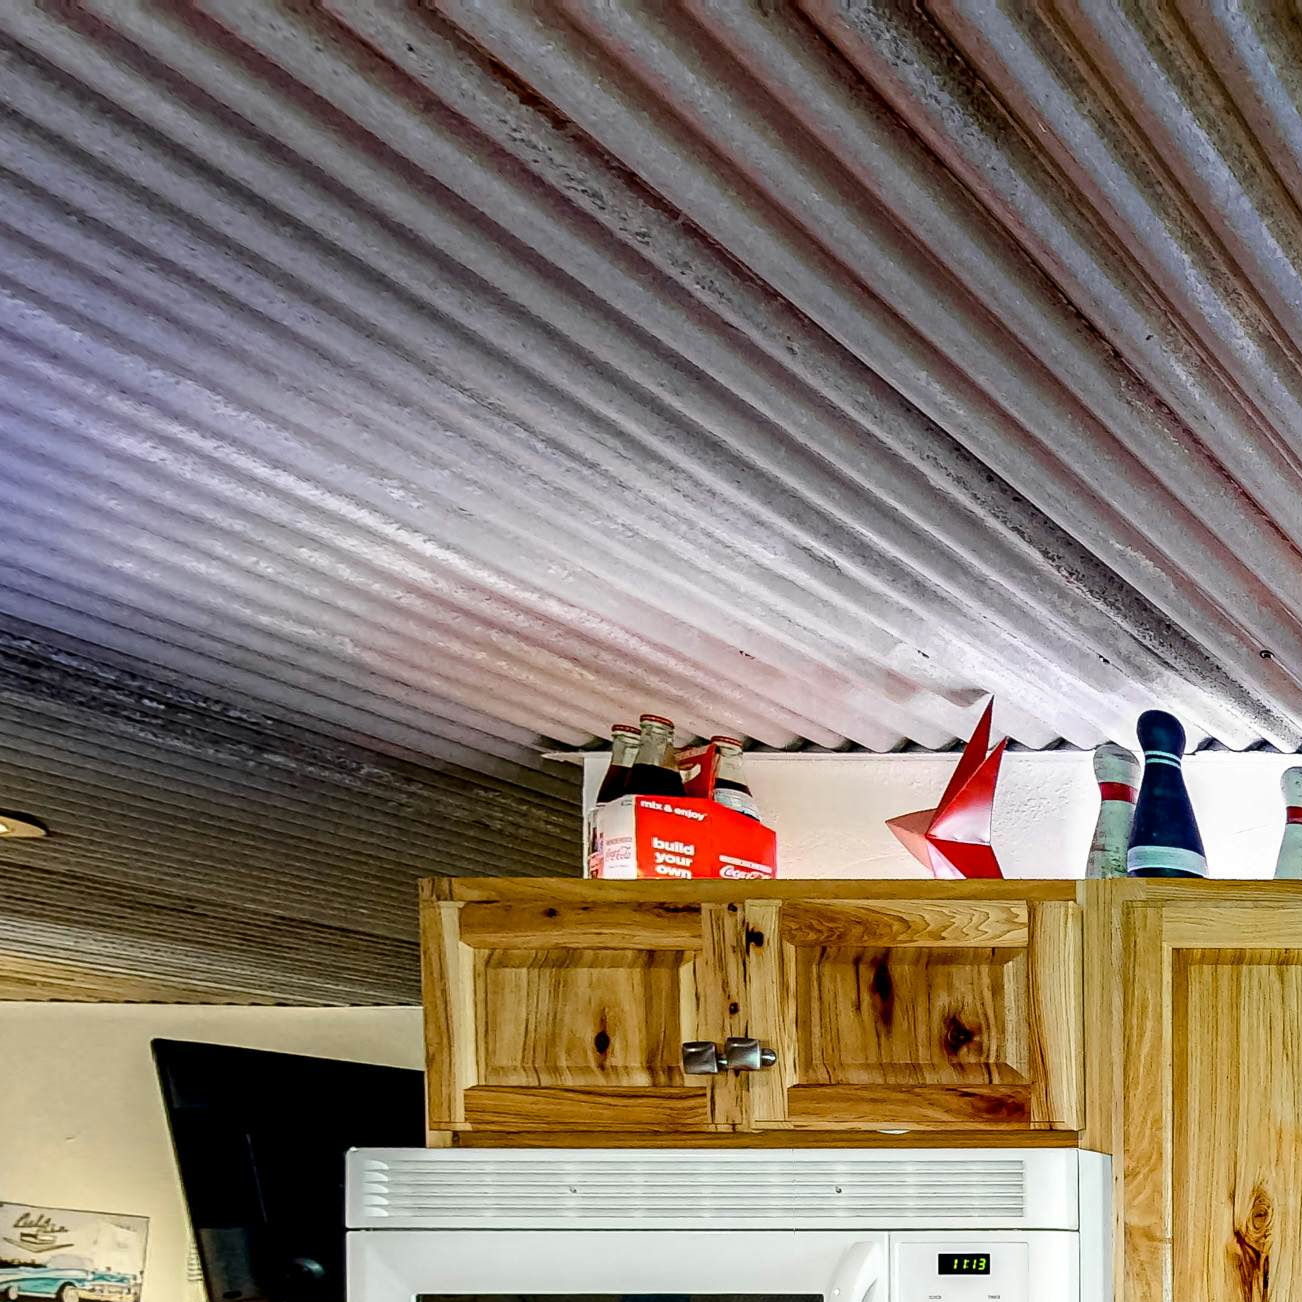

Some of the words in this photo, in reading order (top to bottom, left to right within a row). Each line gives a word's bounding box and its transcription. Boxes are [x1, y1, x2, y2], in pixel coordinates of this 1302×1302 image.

[640, 800, 662, 811] mix
[663, 804, 673, 813] &
[674, 808, 705, 821] enjoy
[652, 836, 695, 856] build
[654, 852, 694, 867] your
[654, 864, 692, 879] own
[952, 1257, 987, 1271] 11:13
